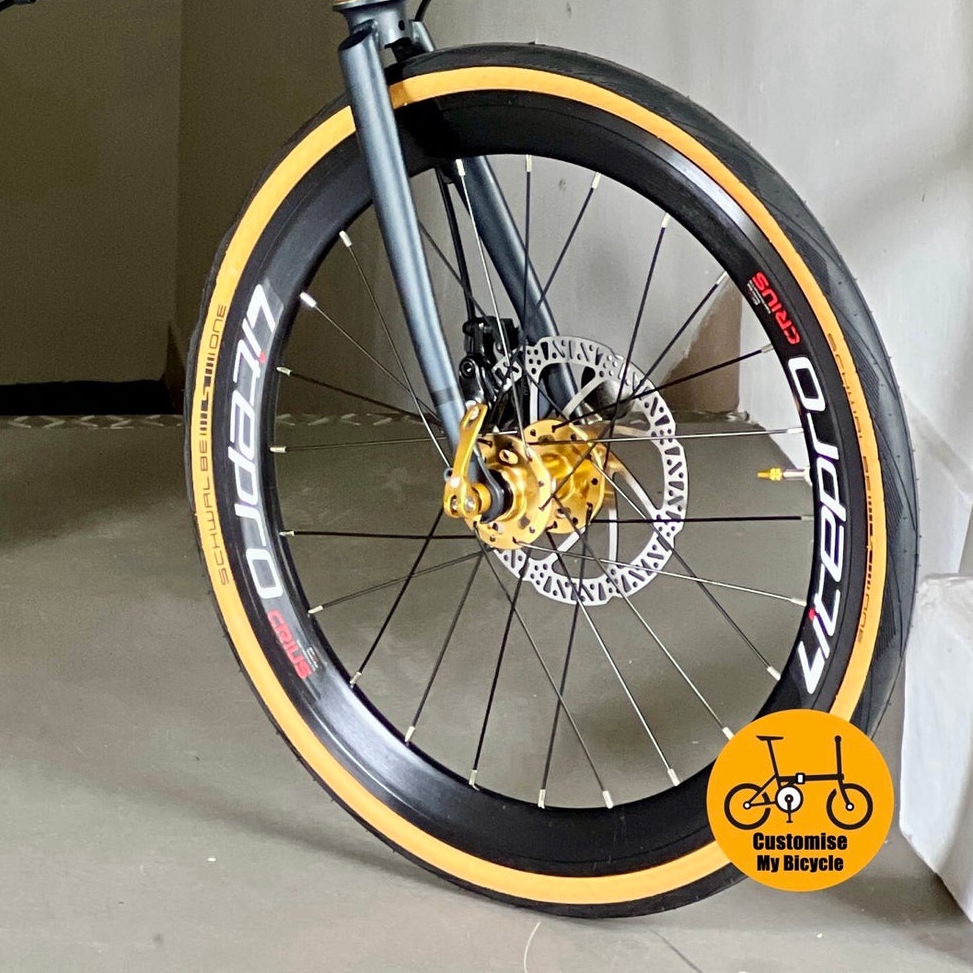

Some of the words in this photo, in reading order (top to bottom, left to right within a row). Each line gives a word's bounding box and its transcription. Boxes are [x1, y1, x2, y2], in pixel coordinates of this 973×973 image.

[209, 304, 228, 350] ONE
[752, 271, 801, 344] CRIUS
[199, 439, 230, 587] SCHWALBE
[268, 609, 312, 680] CRIUS
